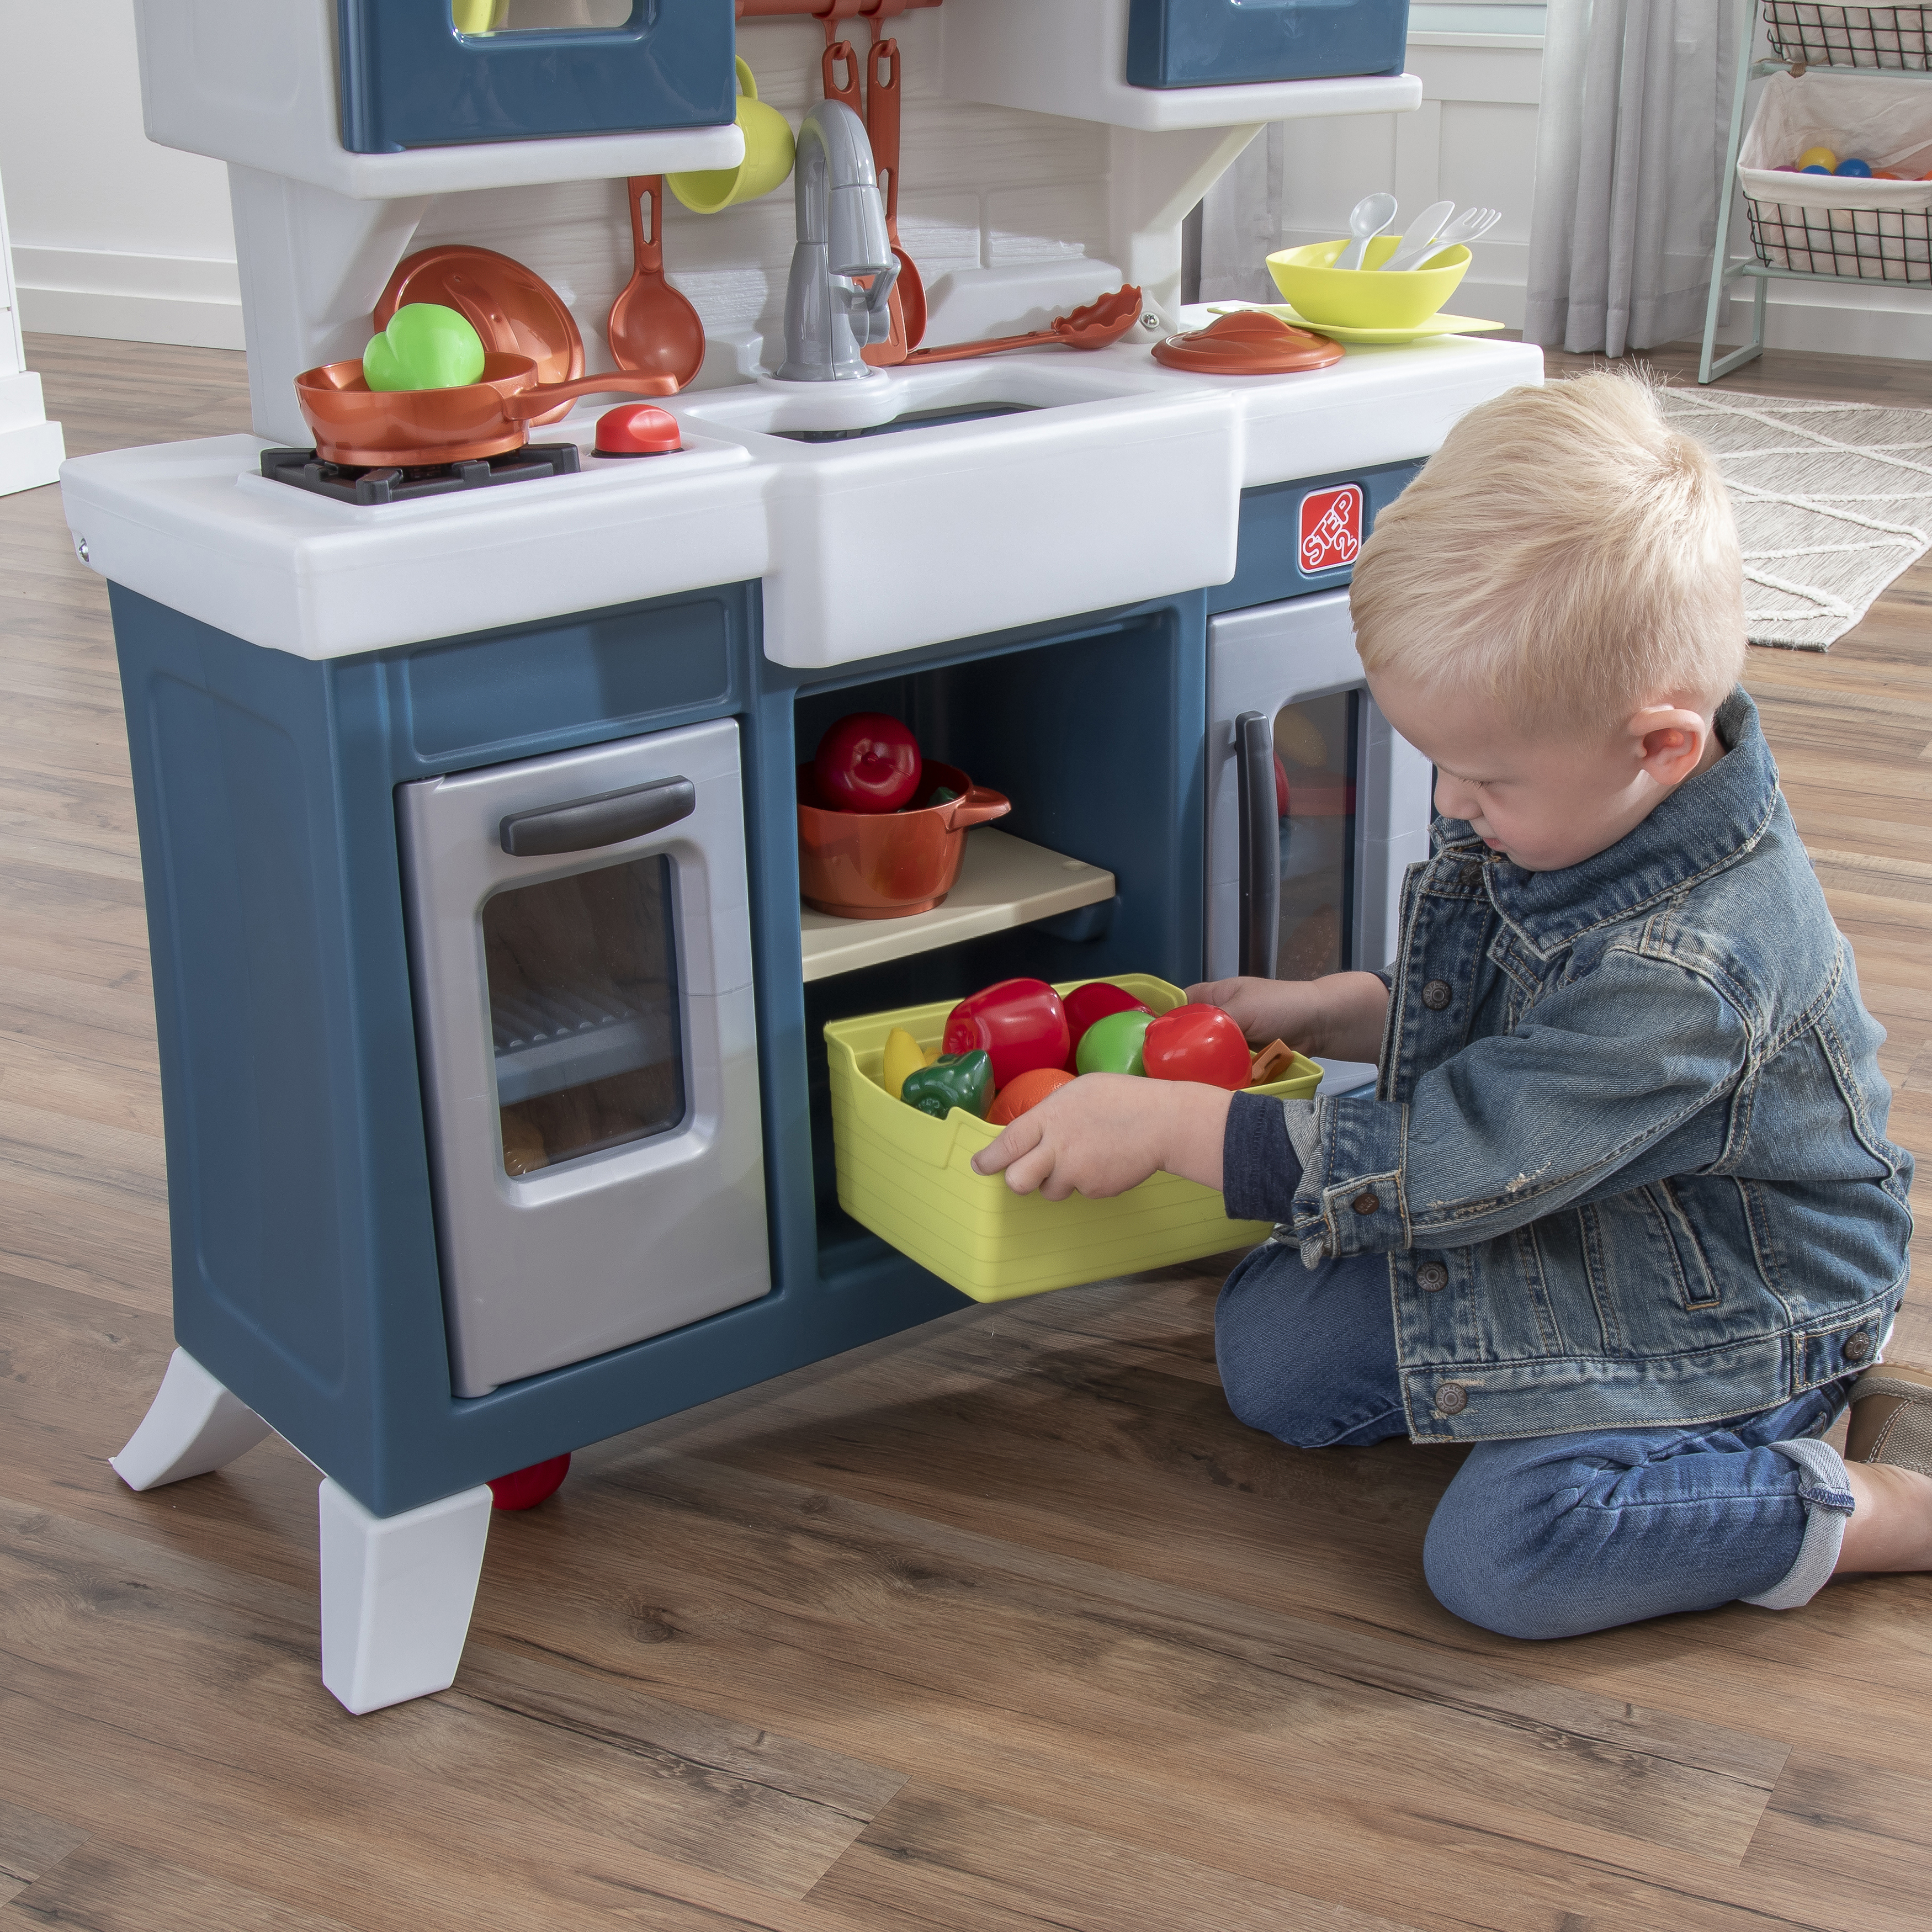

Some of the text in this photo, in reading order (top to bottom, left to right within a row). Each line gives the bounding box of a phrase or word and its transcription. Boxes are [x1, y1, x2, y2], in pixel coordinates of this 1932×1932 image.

[1302, 491, 1352, 565] STEP
[1333, 528, 1357, 560] 2
[1440, 1384, 1464, 1397] PLACE
